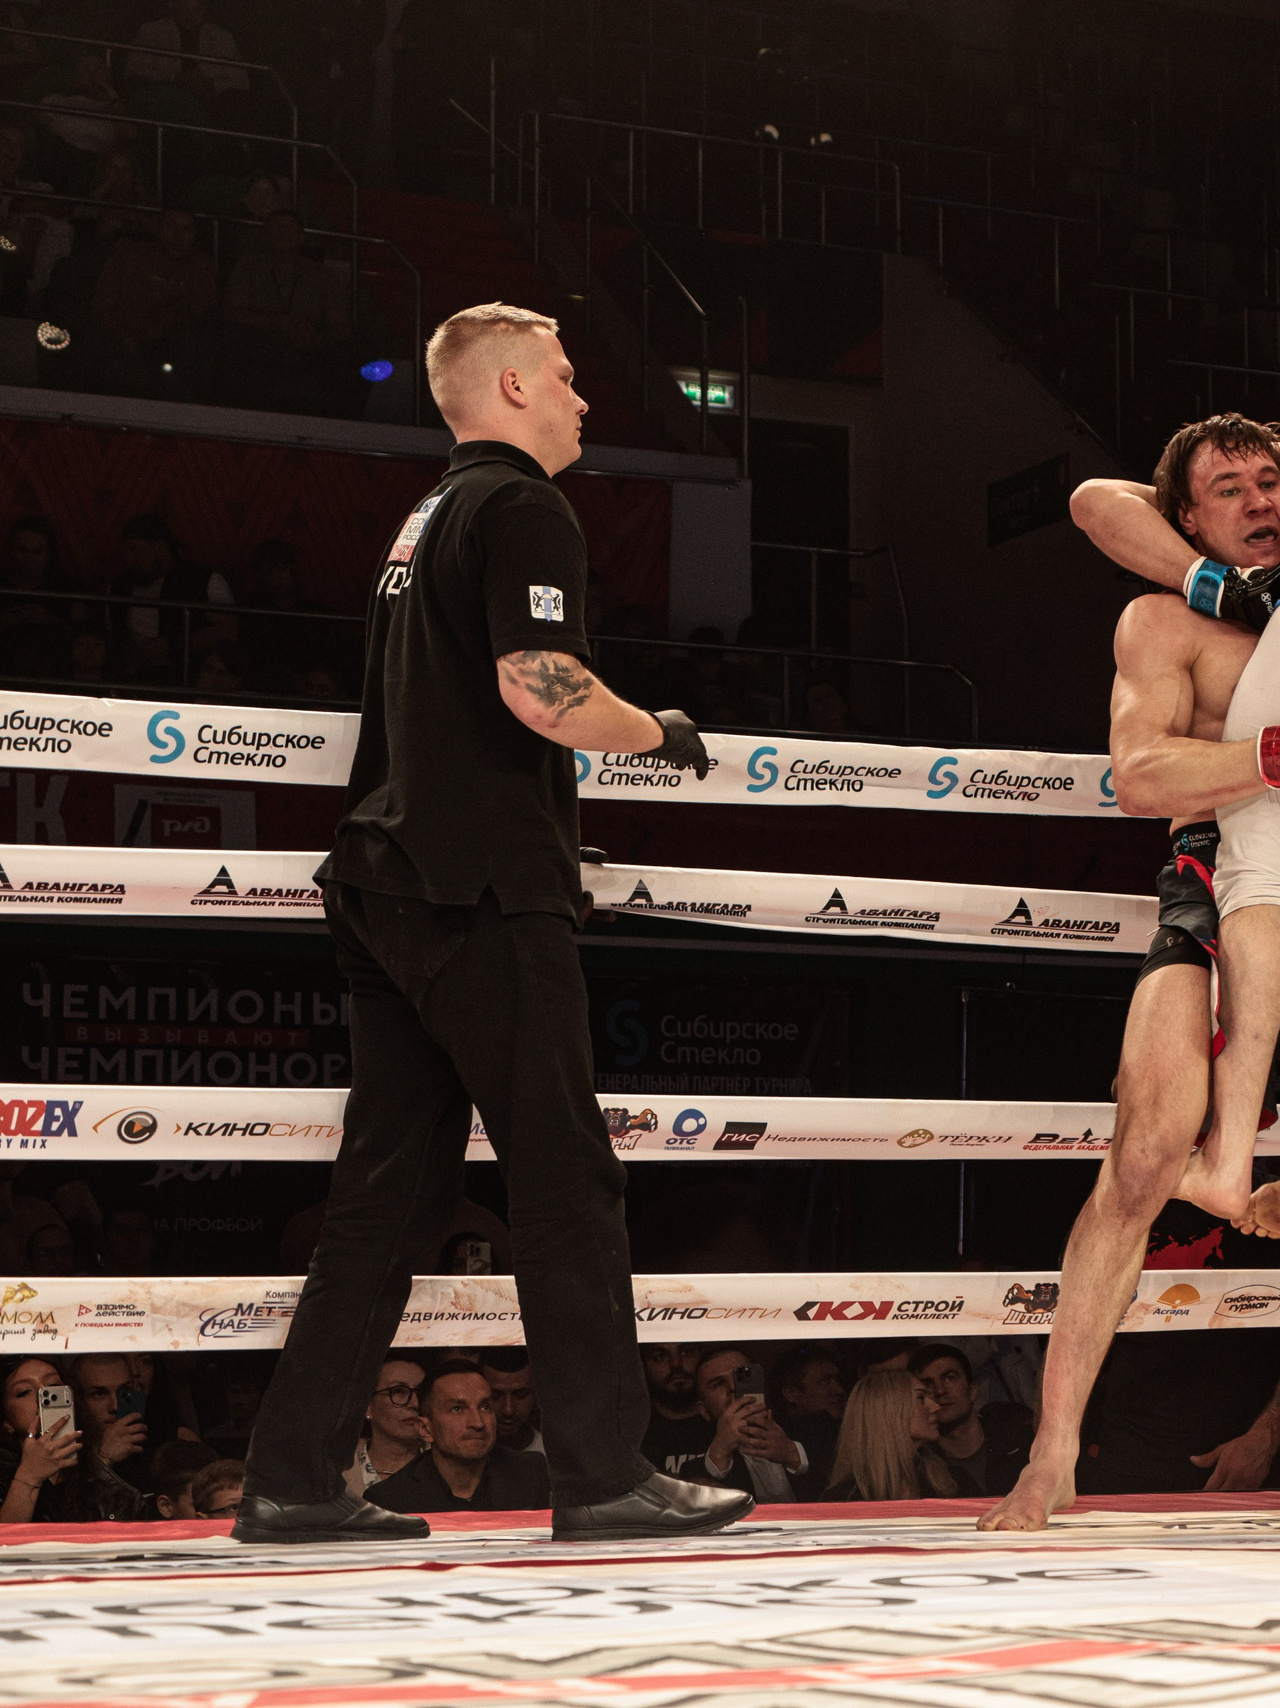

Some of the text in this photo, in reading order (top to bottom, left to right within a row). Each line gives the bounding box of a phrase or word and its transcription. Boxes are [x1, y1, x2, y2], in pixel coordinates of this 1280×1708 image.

[197, 724, 326, 750] Сибирское
[193, 746, 287, 768] Стекло
[789, 759, 902, 780] Сибирское
[597, 768, 682, 788] Стекло
[784, 774, 864, 793] Стекло
[969, 768, 1075, 791] Сибирское
[962, 784, 1040, 801] Стекло
[20, 880, 127, 896] АВАНГАРД
[244, 886, 325, 900] АВАНГА
[56, 896, 124, 904] КОМПАНИЯ
[190, 898, 325, 908] СТРОИТЕЛЬНАЯ КОМПАН
[804, 915, 936, 931] СТРОИТЕЛЬНАЯ КОМПАНИЯ
[856, 908, 941, 922] АВАНГАРД
[1038, 918, 1121, 934] АВАНГАРД
[990, 927, 1115, 942] СТРОИТЕЛЬНАЯ КОМПАНИЯ
[22, 982, 350, 1026] ЧЕМПИОНЫ
[76, 1026, 299, 1046] ВЫЗЫВАЮТ
[660, 1014, 799, 1043] Сибирское
[660, 1041, 762, 1066] Стекло
[755, 1077, 813, 1095] ТУРНИРА
[0, 1099, 84, 1138] OZEX
[20, 1139, 48, 1149] MIX
[665, 1138, 698, 1146] ОТС
[721, 1133, 889, 1144] ГИС Недвижимость
[938, 1132, 1013, 1144] ТЁРКИ
[1028, 1128, 1113, 1145] ВЕКТ
[174, 1215, 263, 1232] ПРОФБОЙ
[265, 1290, 302, 1299] Компан
[896, 1296, 965, 1312] СТРОЙ
[1229, 1302, 1269, 1312] гурман
[400, 1311, 523, 1323] едвижимост
[634, 1307, 783, 1322] КИНОСИТИ
[892, 1312, 960, 1321] КОМПЛЕКТ
[1153, 1308, 1191, 1317] Асгард
